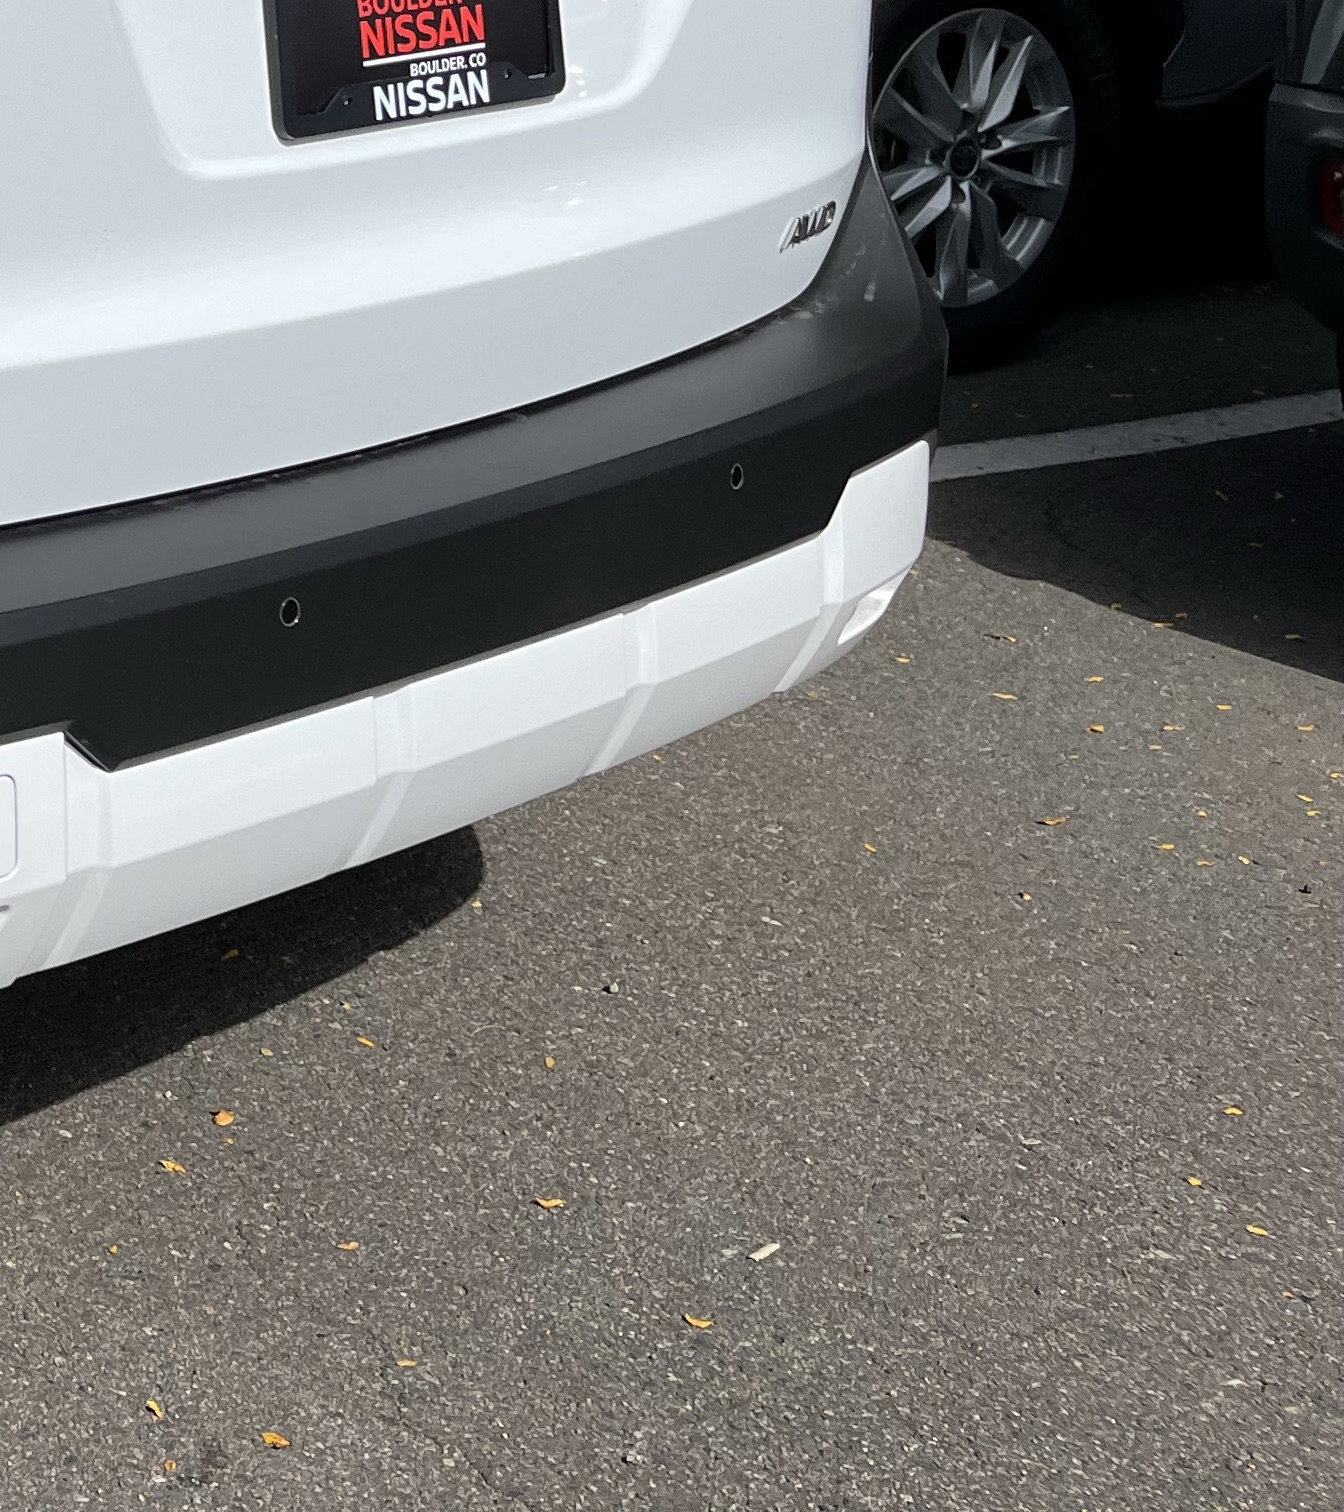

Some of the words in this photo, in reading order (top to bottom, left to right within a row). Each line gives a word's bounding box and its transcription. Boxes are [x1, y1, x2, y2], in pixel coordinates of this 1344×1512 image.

[359, 4, 485, 59] NISSAN
[468, 52, 487, 68] CO
[372, 69, 491, 121] NISSAN
[777, 200, 836, 255] AWD
